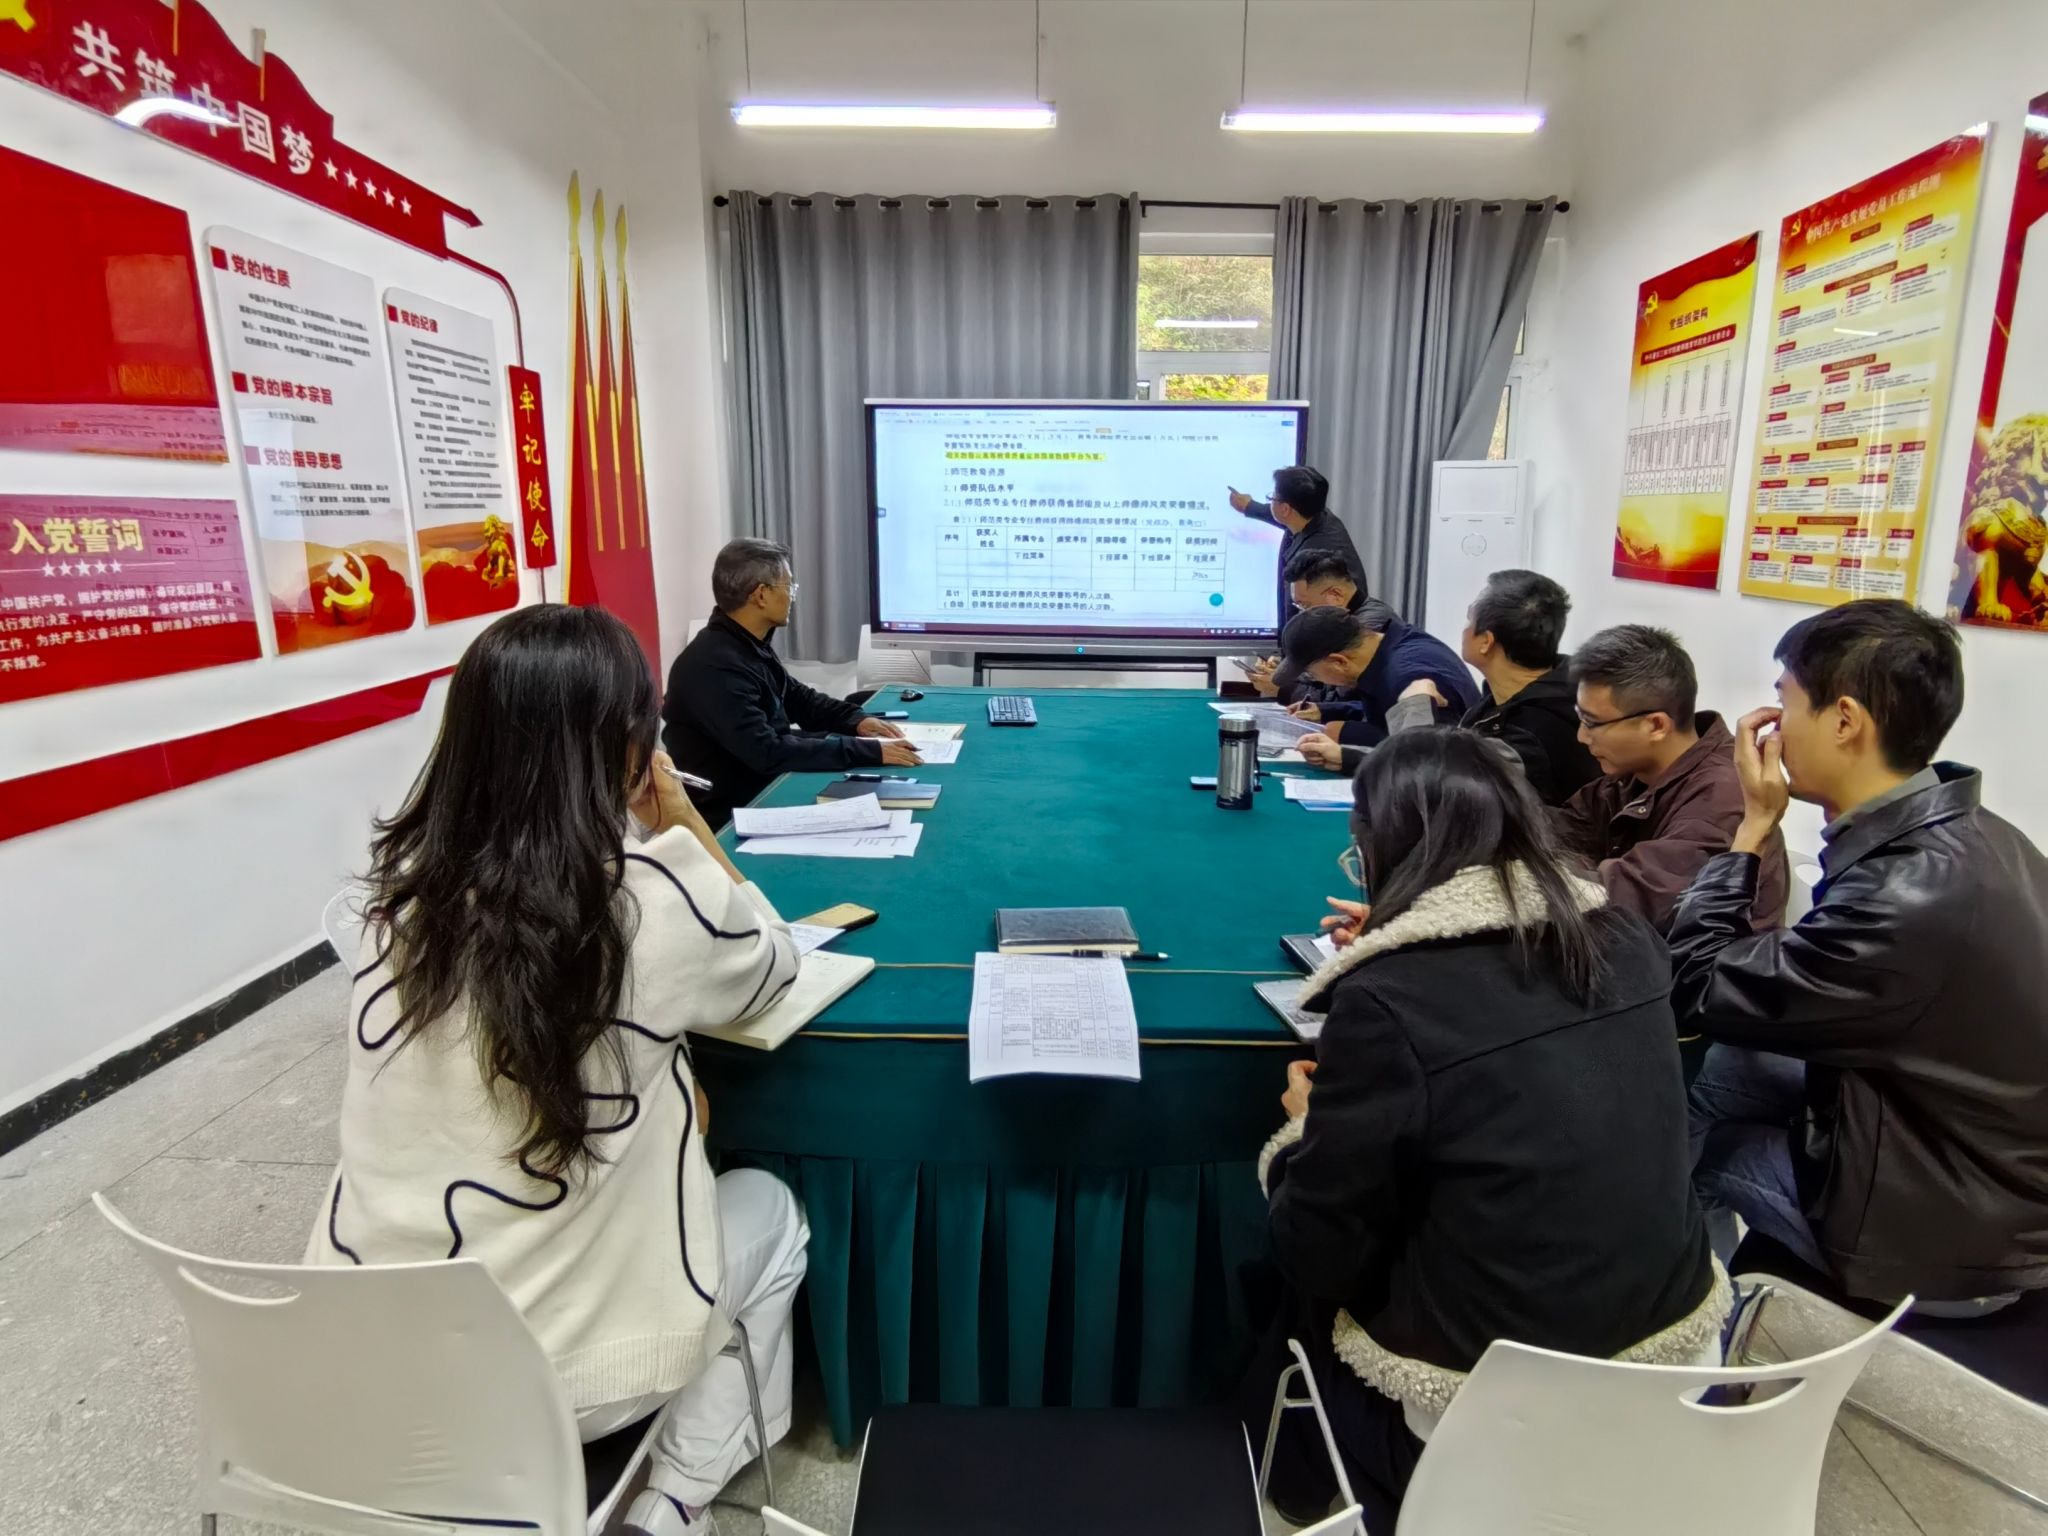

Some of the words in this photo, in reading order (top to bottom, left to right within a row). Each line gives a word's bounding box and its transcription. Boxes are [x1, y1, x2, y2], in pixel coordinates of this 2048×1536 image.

[72, 20, 315, 175] 共筑中国梦
[231, 253, 292, 289] 党的性质
[400, 309, 439, 334] 党的纪律
[251, 375, 334, 405] 党的根本宗旨
[264, 447, 344, 470] 党的指导思想
[10, 517, 145, 556] 入党誓词
[944, 534, 960, 543] 序号
[1014, 534, 1045, 543] 所属专业
